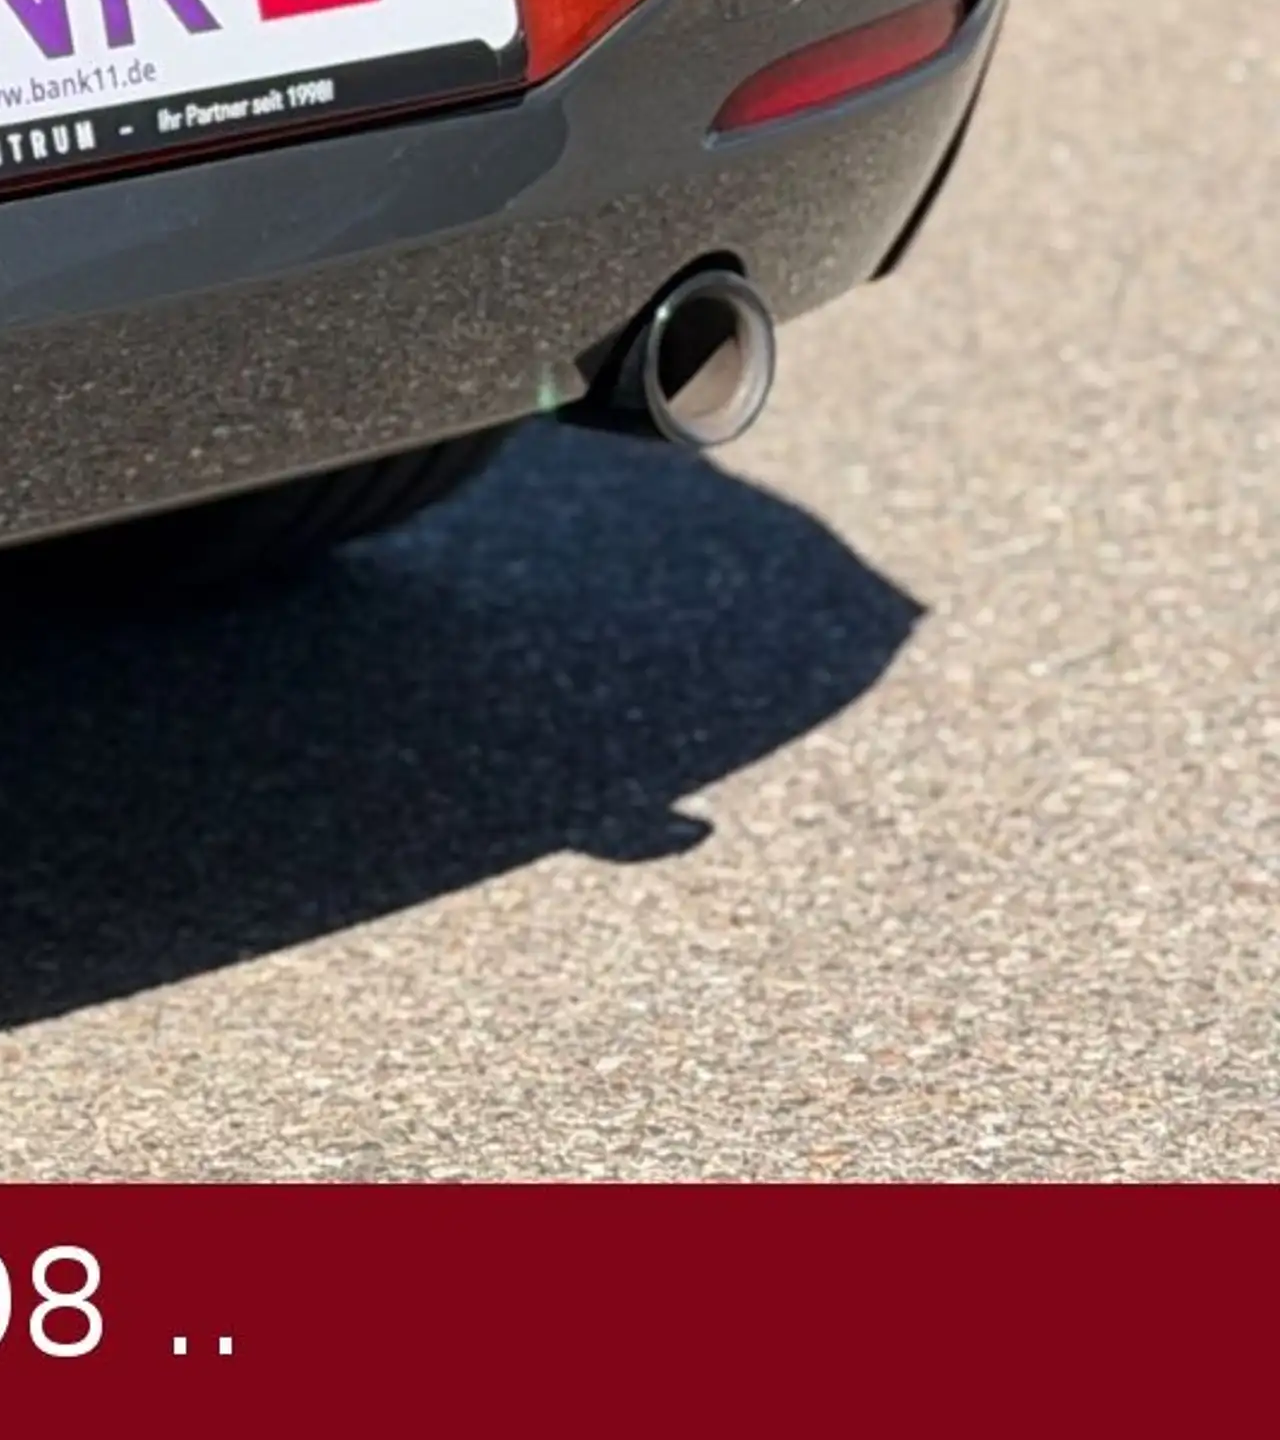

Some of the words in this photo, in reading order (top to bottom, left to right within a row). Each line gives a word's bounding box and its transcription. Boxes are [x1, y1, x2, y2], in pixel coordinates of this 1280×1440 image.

[157, 107, 183, 133] Ihr
[185, 98, 248, 128] Partner
[252, 88, 285, 116] seit
